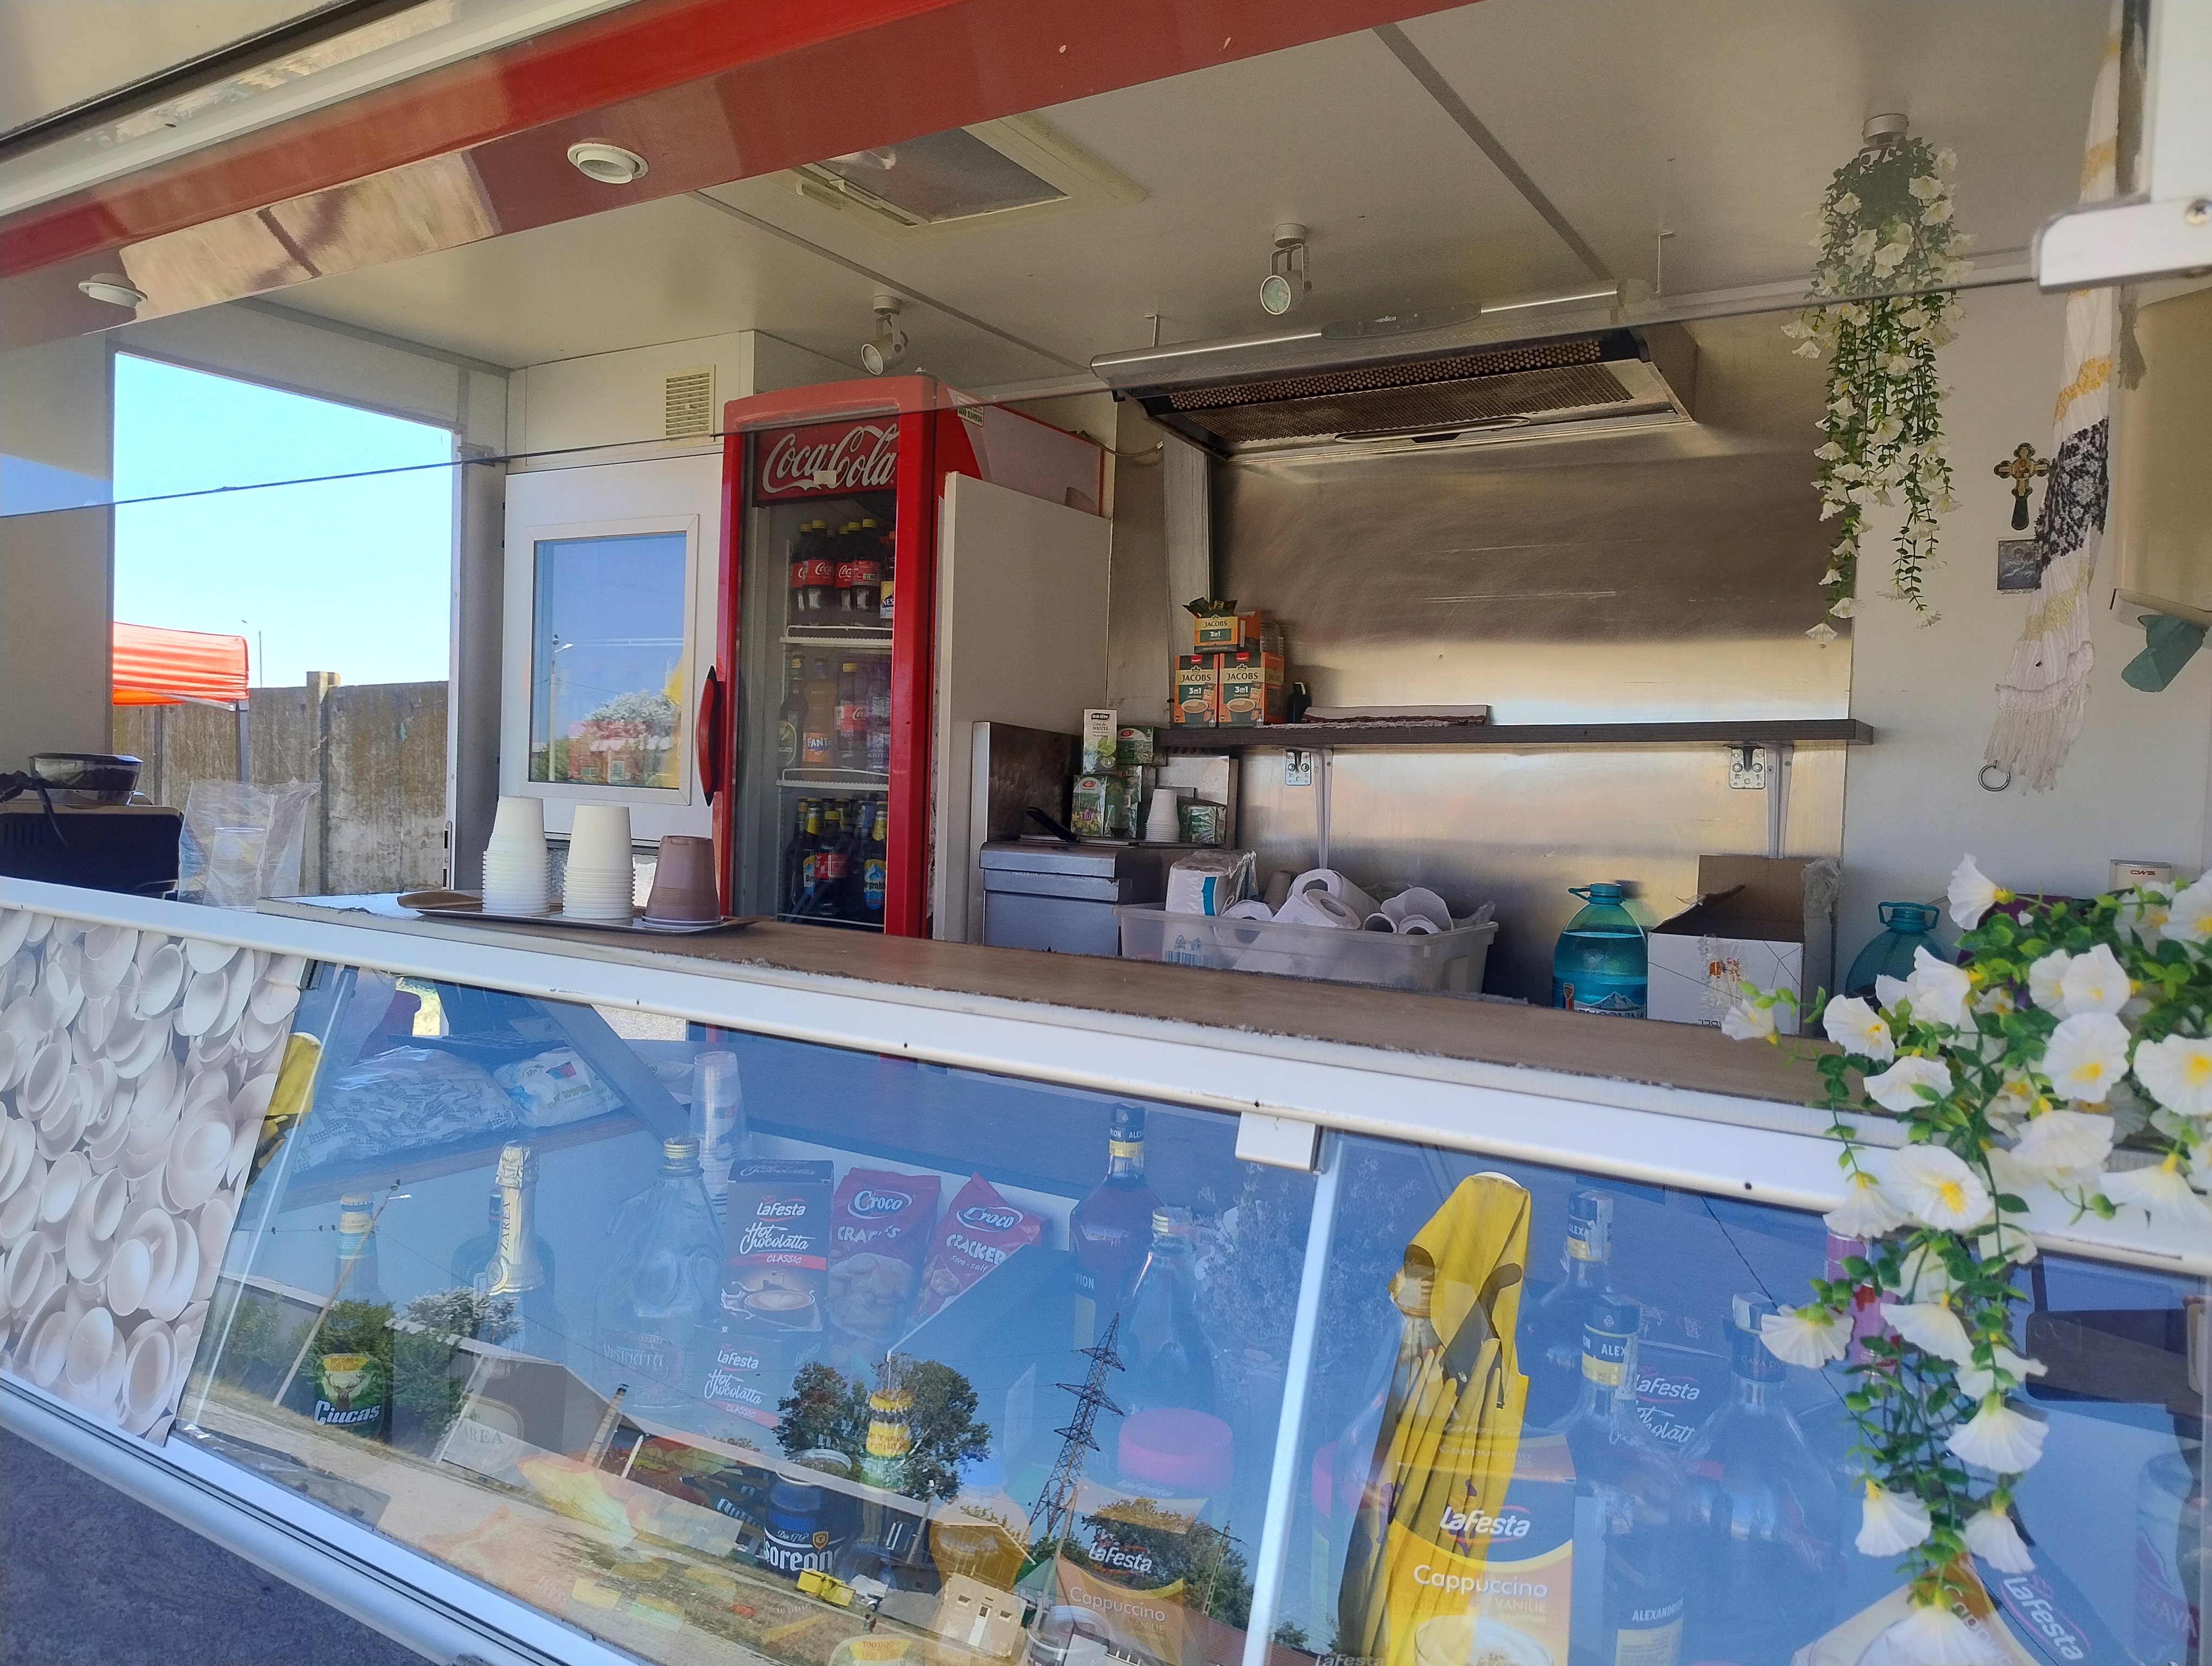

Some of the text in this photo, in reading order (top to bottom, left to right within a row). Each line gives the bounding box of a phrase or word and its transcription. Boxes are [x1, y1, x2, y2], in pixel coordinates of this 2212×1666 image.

[1181, 674, 1211, 682] JACOBS
[1226, 672, 1258, 681] JACOBS
[756, 1202, 806, 1215] LaFesta
[500, 1202, 511, 1252] ZAREA
[745, 1222, 788, 1239] Hot
[740, 1234, 815, 1254] Chocolatta
[766, 1254, 802, 1264] CLASSIC
[717, 1349, 759, 1369] LaFesta
[709, 1369, 744, 1386] Hot
[704, 1380, 768, 1406] Chocolatta
[725, 1404, 756, 1418] CLASSIC
[1440, 1506, 1531, 1538] LaFesta
[1089, 1542, 1153, 1573] LaFesta
[1413, 1564, 1548, 1598] Cappuccino
[1070, 1586, 1166, 1622] Cappuccino
[1495, 1598, 1545, 1612] VANILIE
[2003, 1577, 2084, 1660] LaFesta
